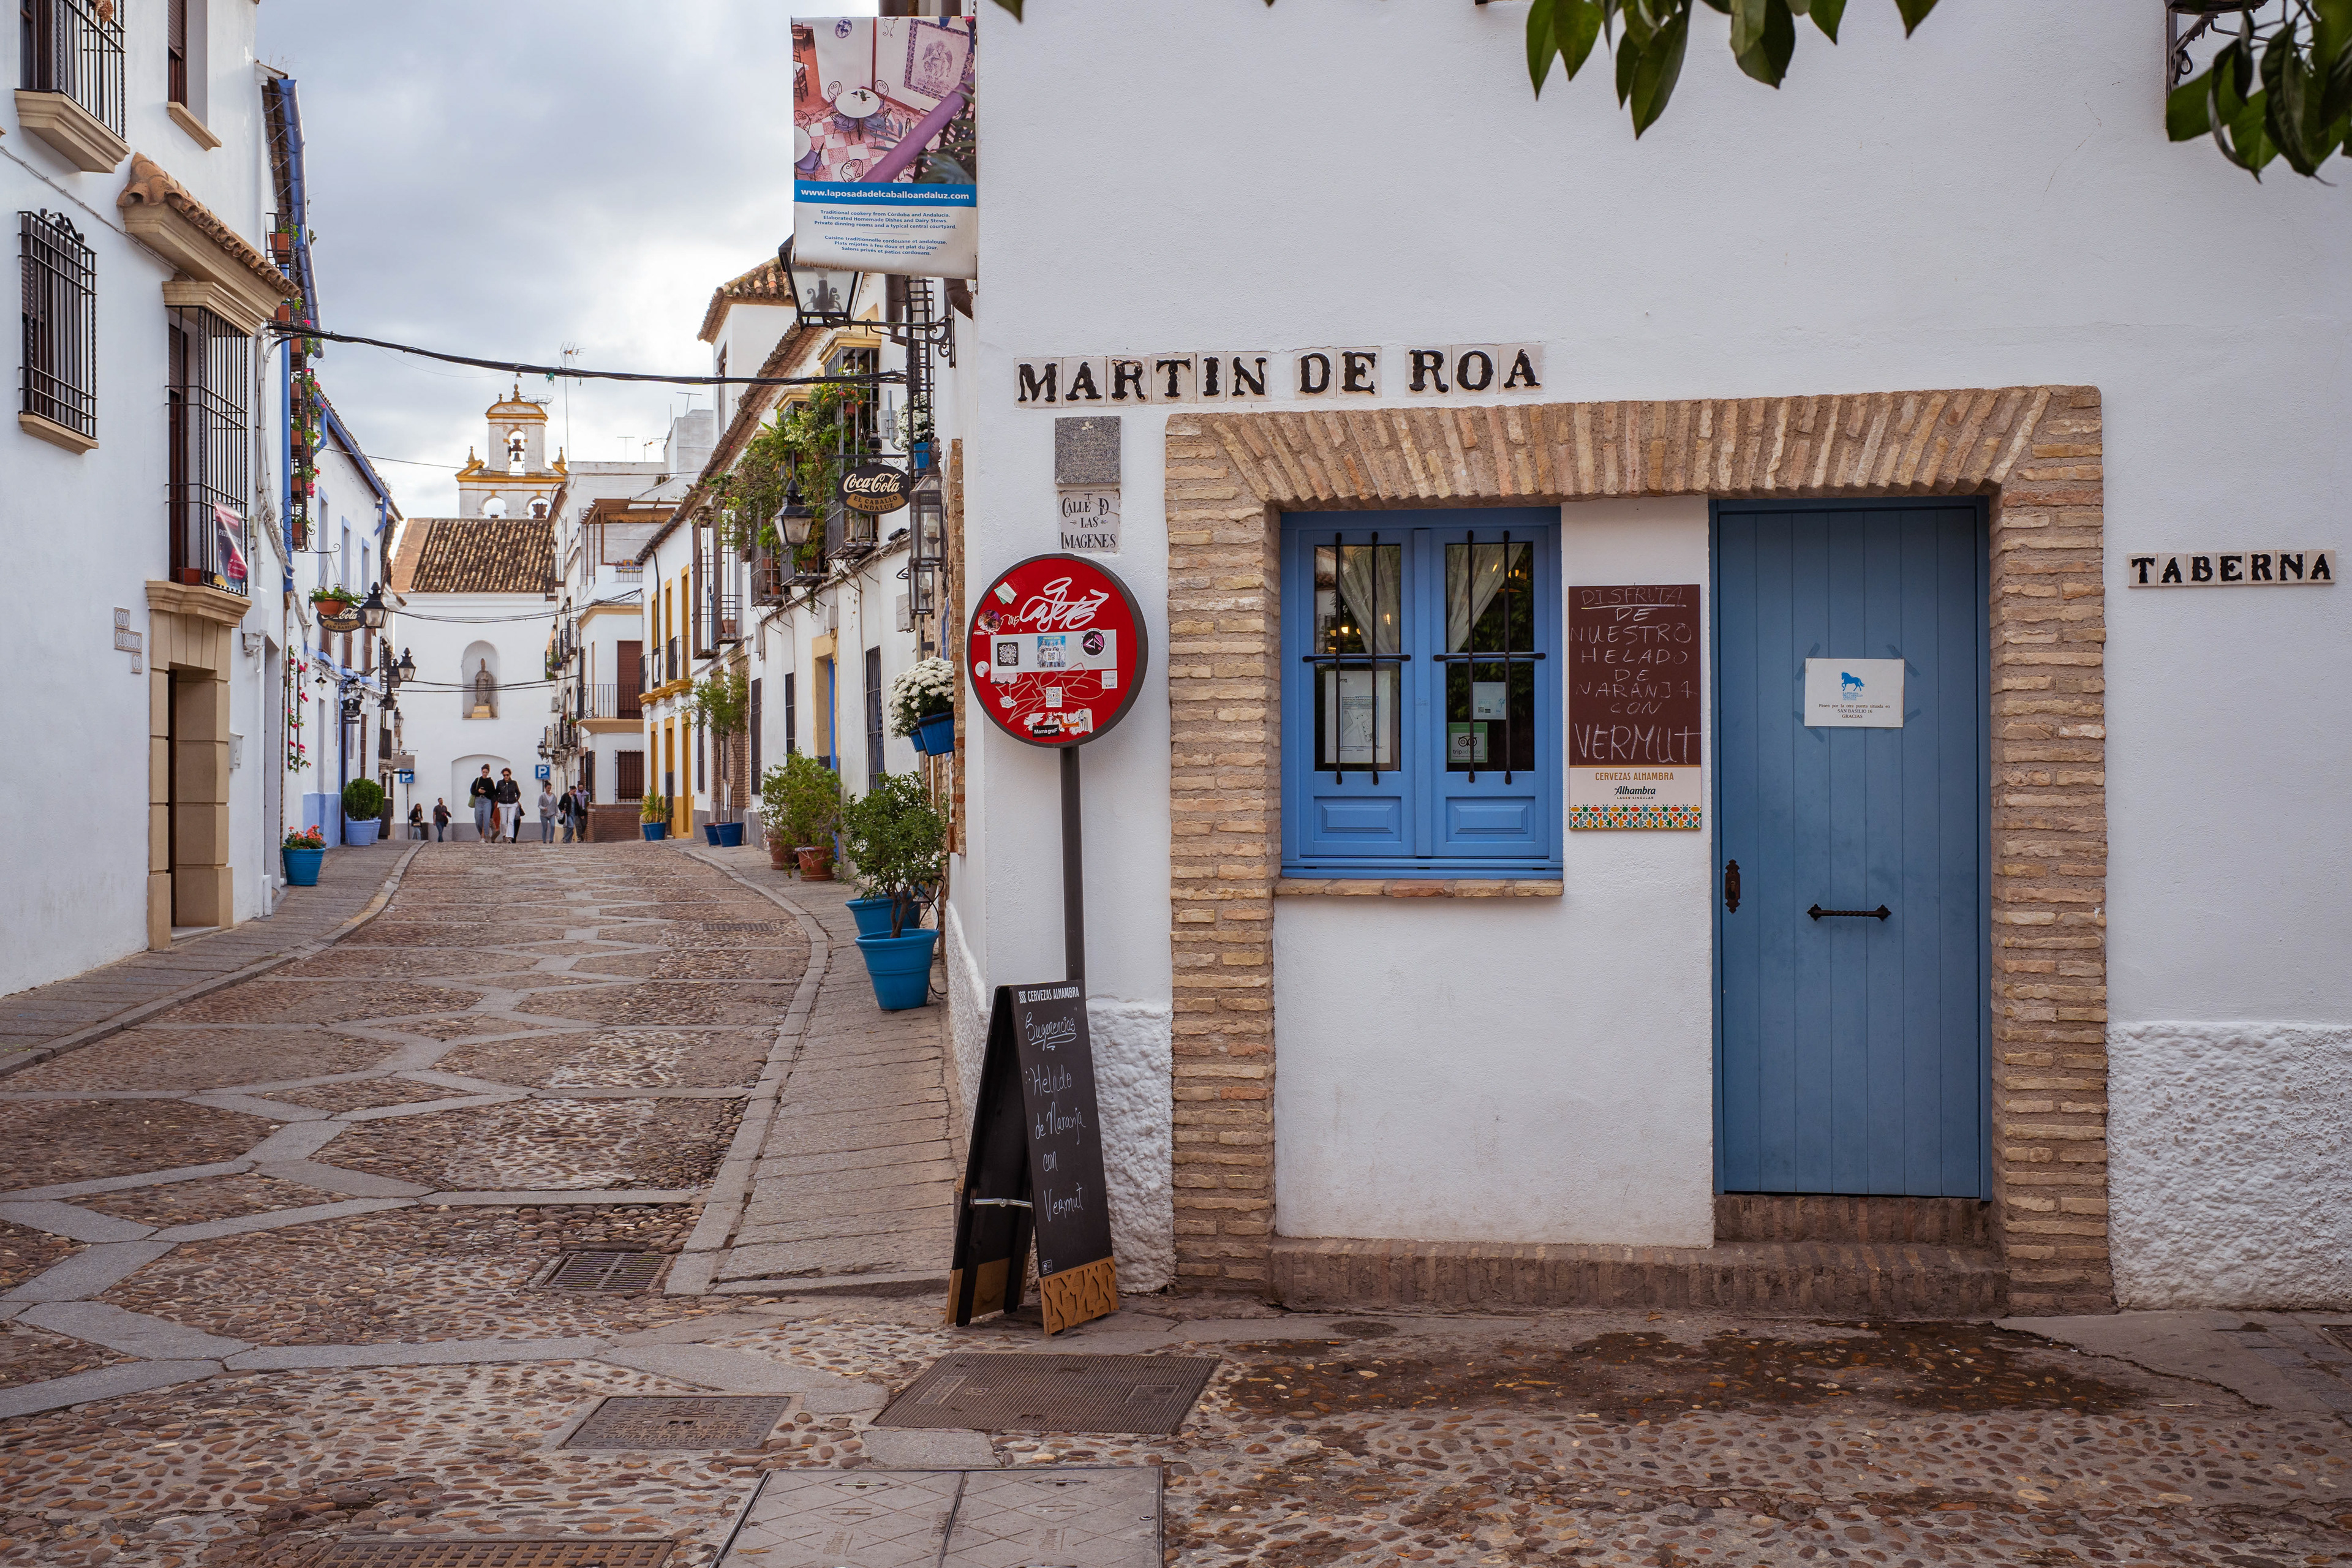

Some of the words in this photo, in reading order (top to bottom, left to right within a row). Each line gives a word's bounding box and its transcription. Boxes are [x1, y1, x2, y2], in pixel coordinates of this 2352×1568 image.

[801, 189, 970, 200] www.laposadadelcaballoandaluz.com
[1019, 356, 1267, 402] MARTIN
[1298, 351, 1376, 395] DE
[1409, 349, 1541, 394] ROA
[843, 473, 902, 493] Coca-Cola
[858, 502, 894, 511] ANDALUZ
[865, 496, 897, 505] CABALLO
[1061, 497, 1091, 518] CALLE
[1080, 516, 1099, 528] LAS
[1061, 532, 1117, 549] IMAGENES
[2131, 553, 2331, 584] TABERNA
[1581, 586, 1683, 606] DISFRUTA
[117, 612, 129, 625] SAN
[1615, 607, 1659, 622] DE
[117, 633, 141, 647] BASILIO
[1569, 622, 1692, 646] NUESTRO
[1580, 648, 1688, 665] HELADO
[1614, 668, 1649, 682] DE
[1575, 680, 1697, 699] NARANJA
[1610, 701, 1662, 715] CON
[1575, 723, 1702, 764] VERMUT
[538, 766, 548, 778] P
[1614, 786, 1656, 796] Alhambra
[1027, 989, 1052, 1002] CERVEZAS
[1053, 987, 1080, 1000] ALHAMBRA
[1030, 1064, 1072, 1096] Helado
[1035, 1112, 1046, 1139] de
[1046, 1101, 1086, 1145] Naranja
[1043, 1151, 1058, 1172] con
[1044, 1182, 1084, 1222] Vermut
